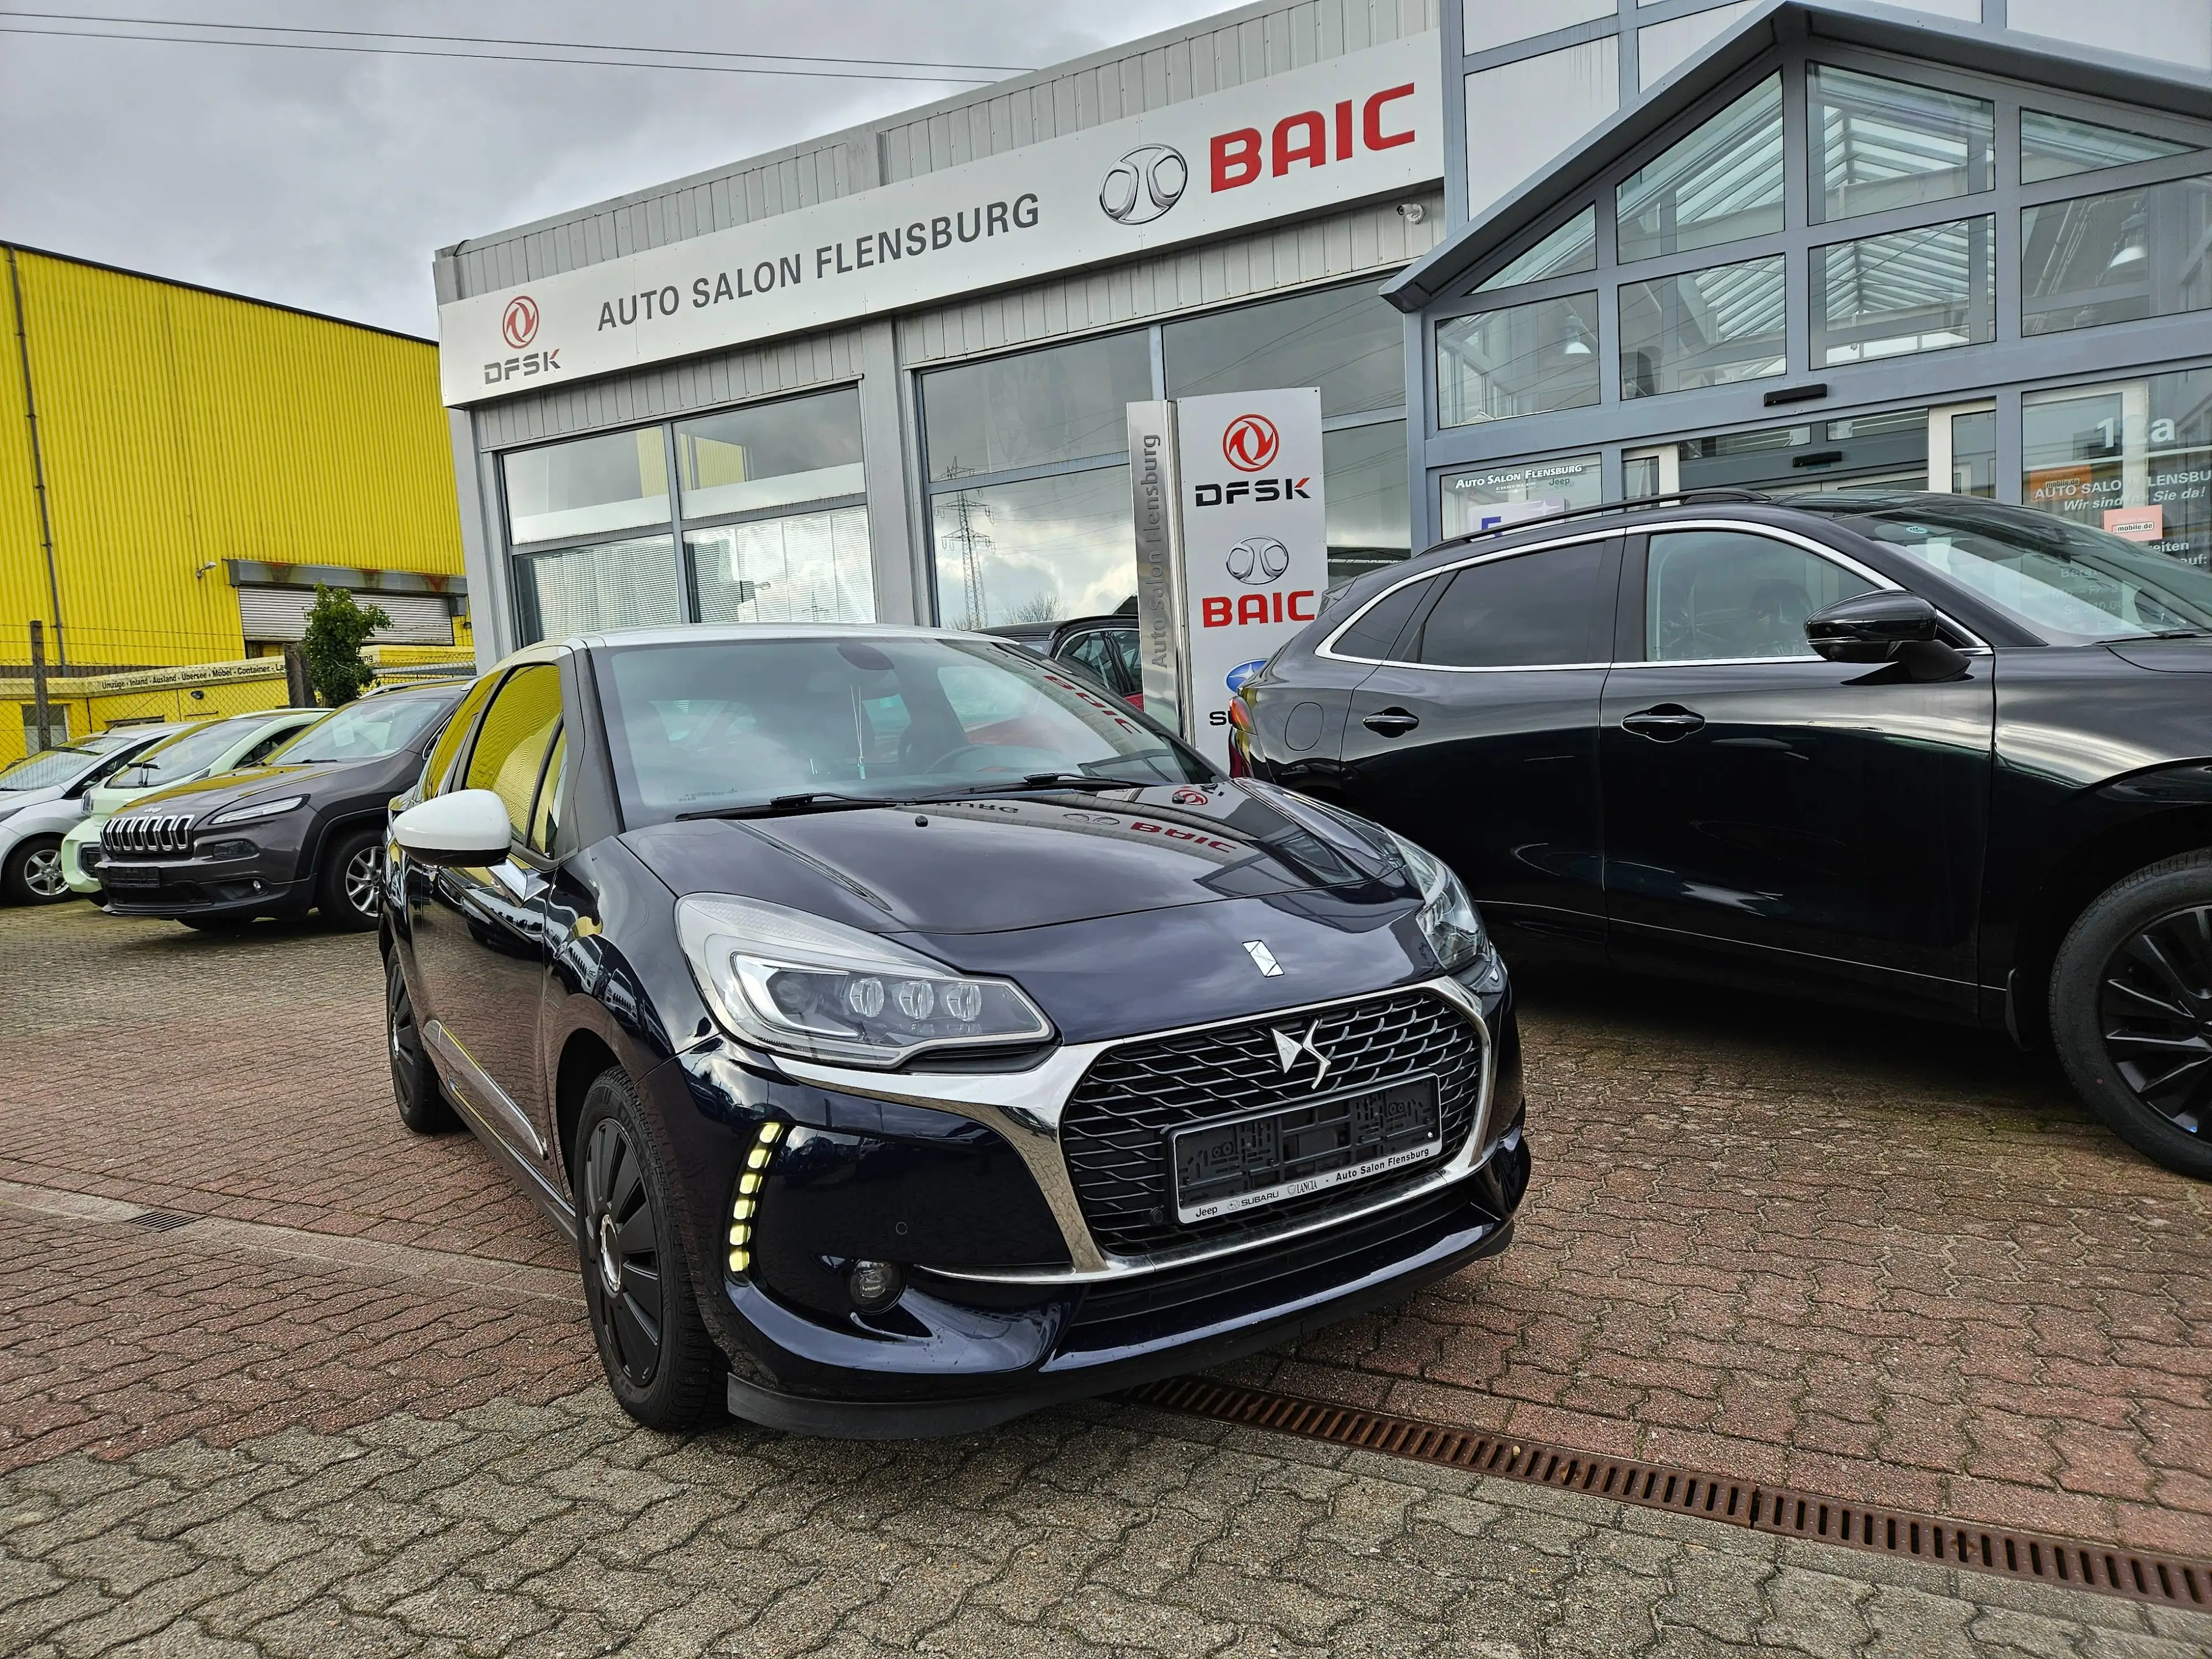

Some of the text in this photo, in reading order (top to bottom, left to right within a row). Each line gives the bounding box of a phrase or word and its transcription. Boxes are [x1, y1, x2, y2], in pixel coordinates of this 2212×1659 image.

[1210, 82, 1415, 193] BAIC
[597, 192, 1039, 331] AUTO SALON FLENSBURG
[484, 349, 561, 385] DFSK
[1455, 464, 1583, 489] AUTO SALON FLENSBURG
[1549, 477, 1570, 486] Jeep
[2034, 469, 2212, 499] AUTO SALO LENSBU
[1195, 478, 1312, 507] DFSK
[2064, 499, 2089, 512] Wir
[2153, 490, 2177, 502] Sie
[2181, 486, 2206, 499] da!
[2118, 522, 2153, 532] mobile.de
[1141, 434, 1168, 669] Auto Salon Flensburg
[2149, 541, 2190, 552] eiten
[1202, 590, 1315, 628] BAIC
[153, 675, 177, 684] Ausland
[181, 671, 207, 680] Übersee
[238, 665, 270, 675] Container
[1195, 1148, 1429, 1217] Jeep SUBARU LANCIA Auto Salon Flensburg
